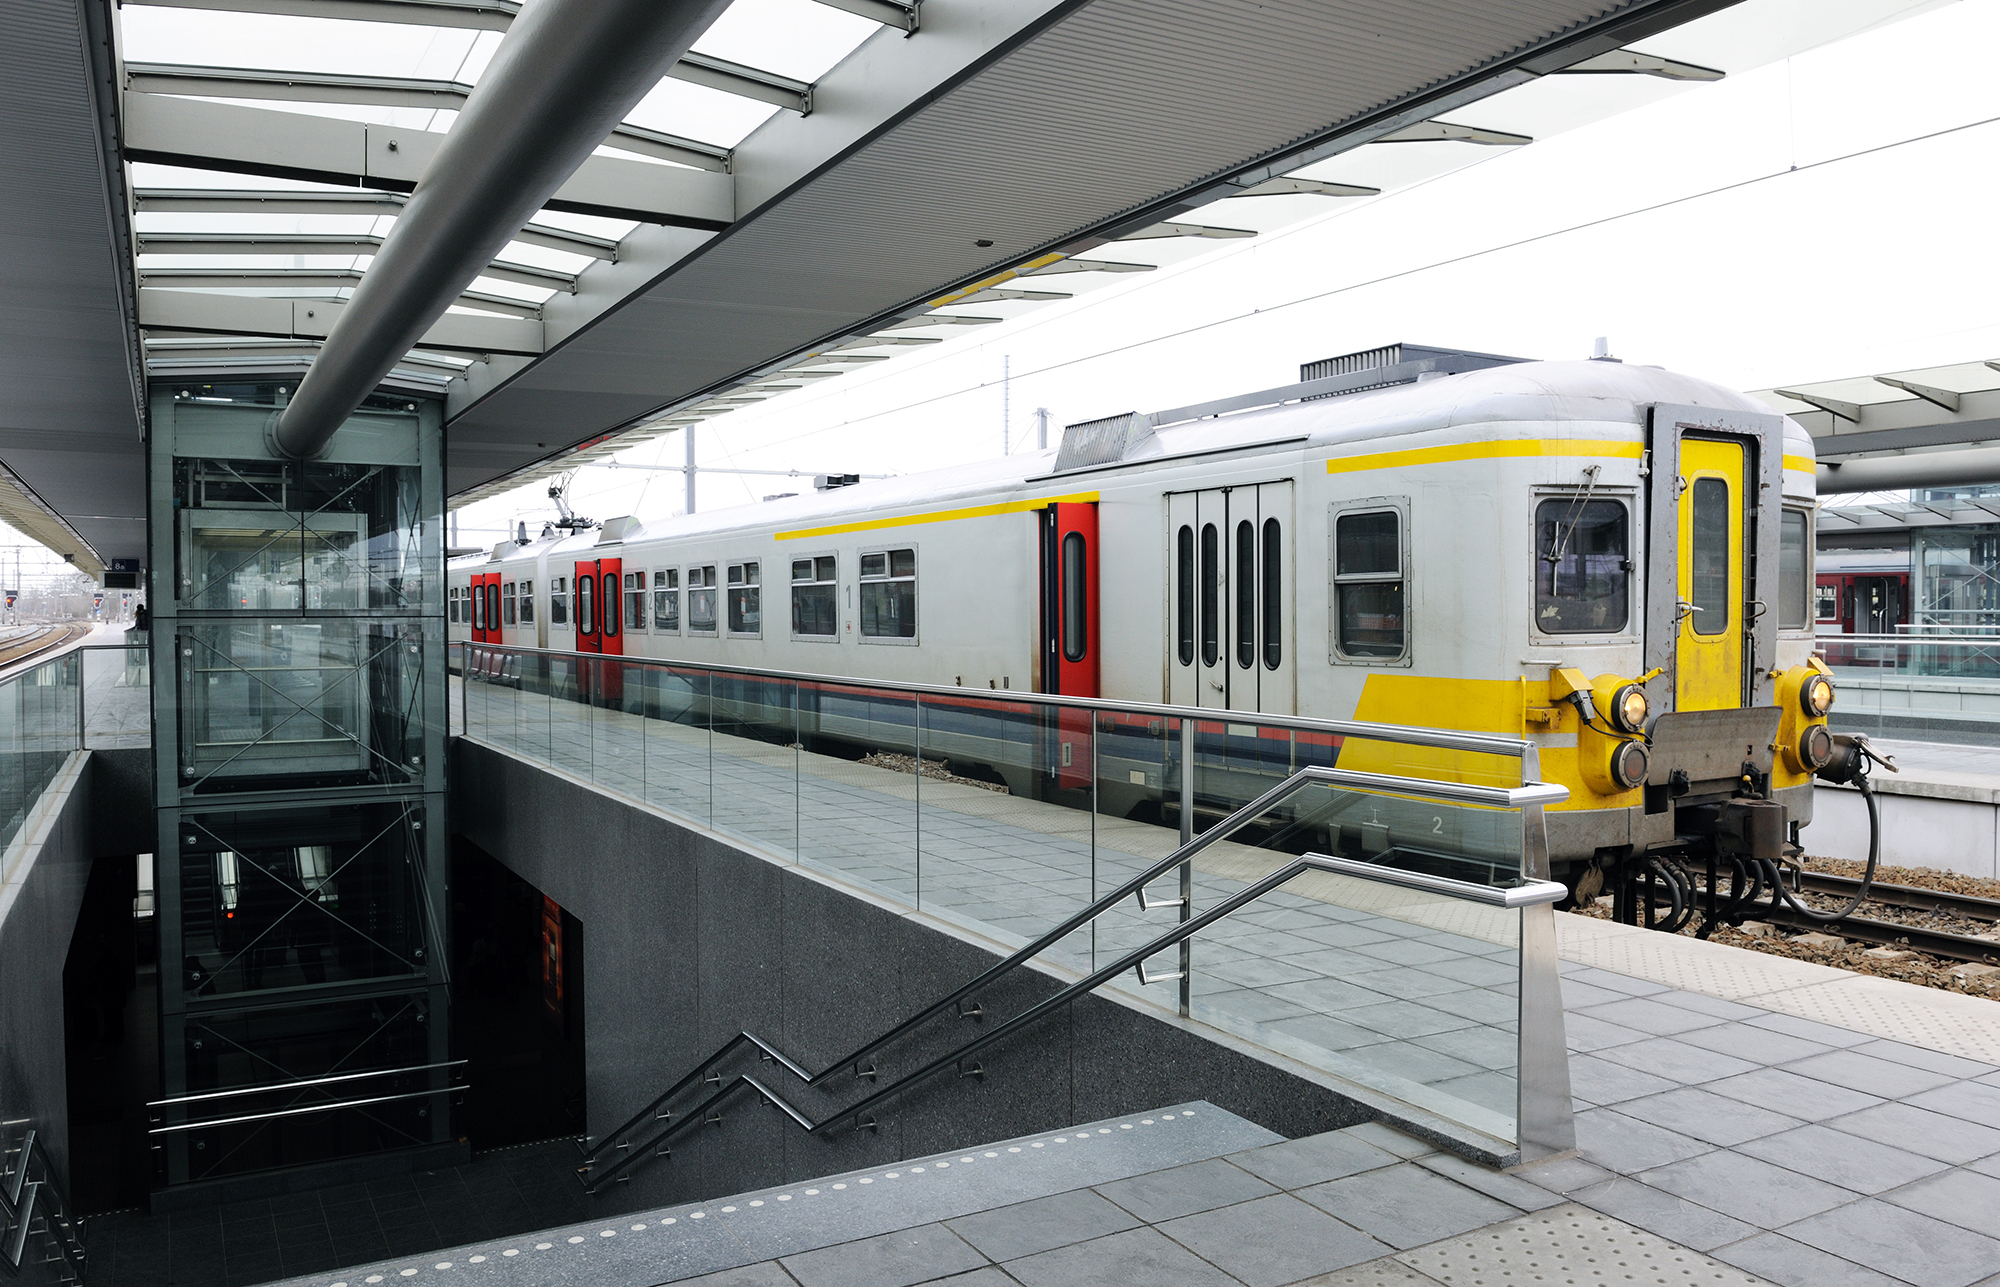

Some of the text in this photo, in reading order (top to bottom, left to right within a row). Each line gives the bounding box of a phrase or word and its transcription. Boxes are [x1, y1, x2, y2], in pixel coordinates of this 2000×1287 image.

[648, 592, 652, 610] 2
[846, 584, 851, 608] 1
[1432, 816, 1443, 834] 2
